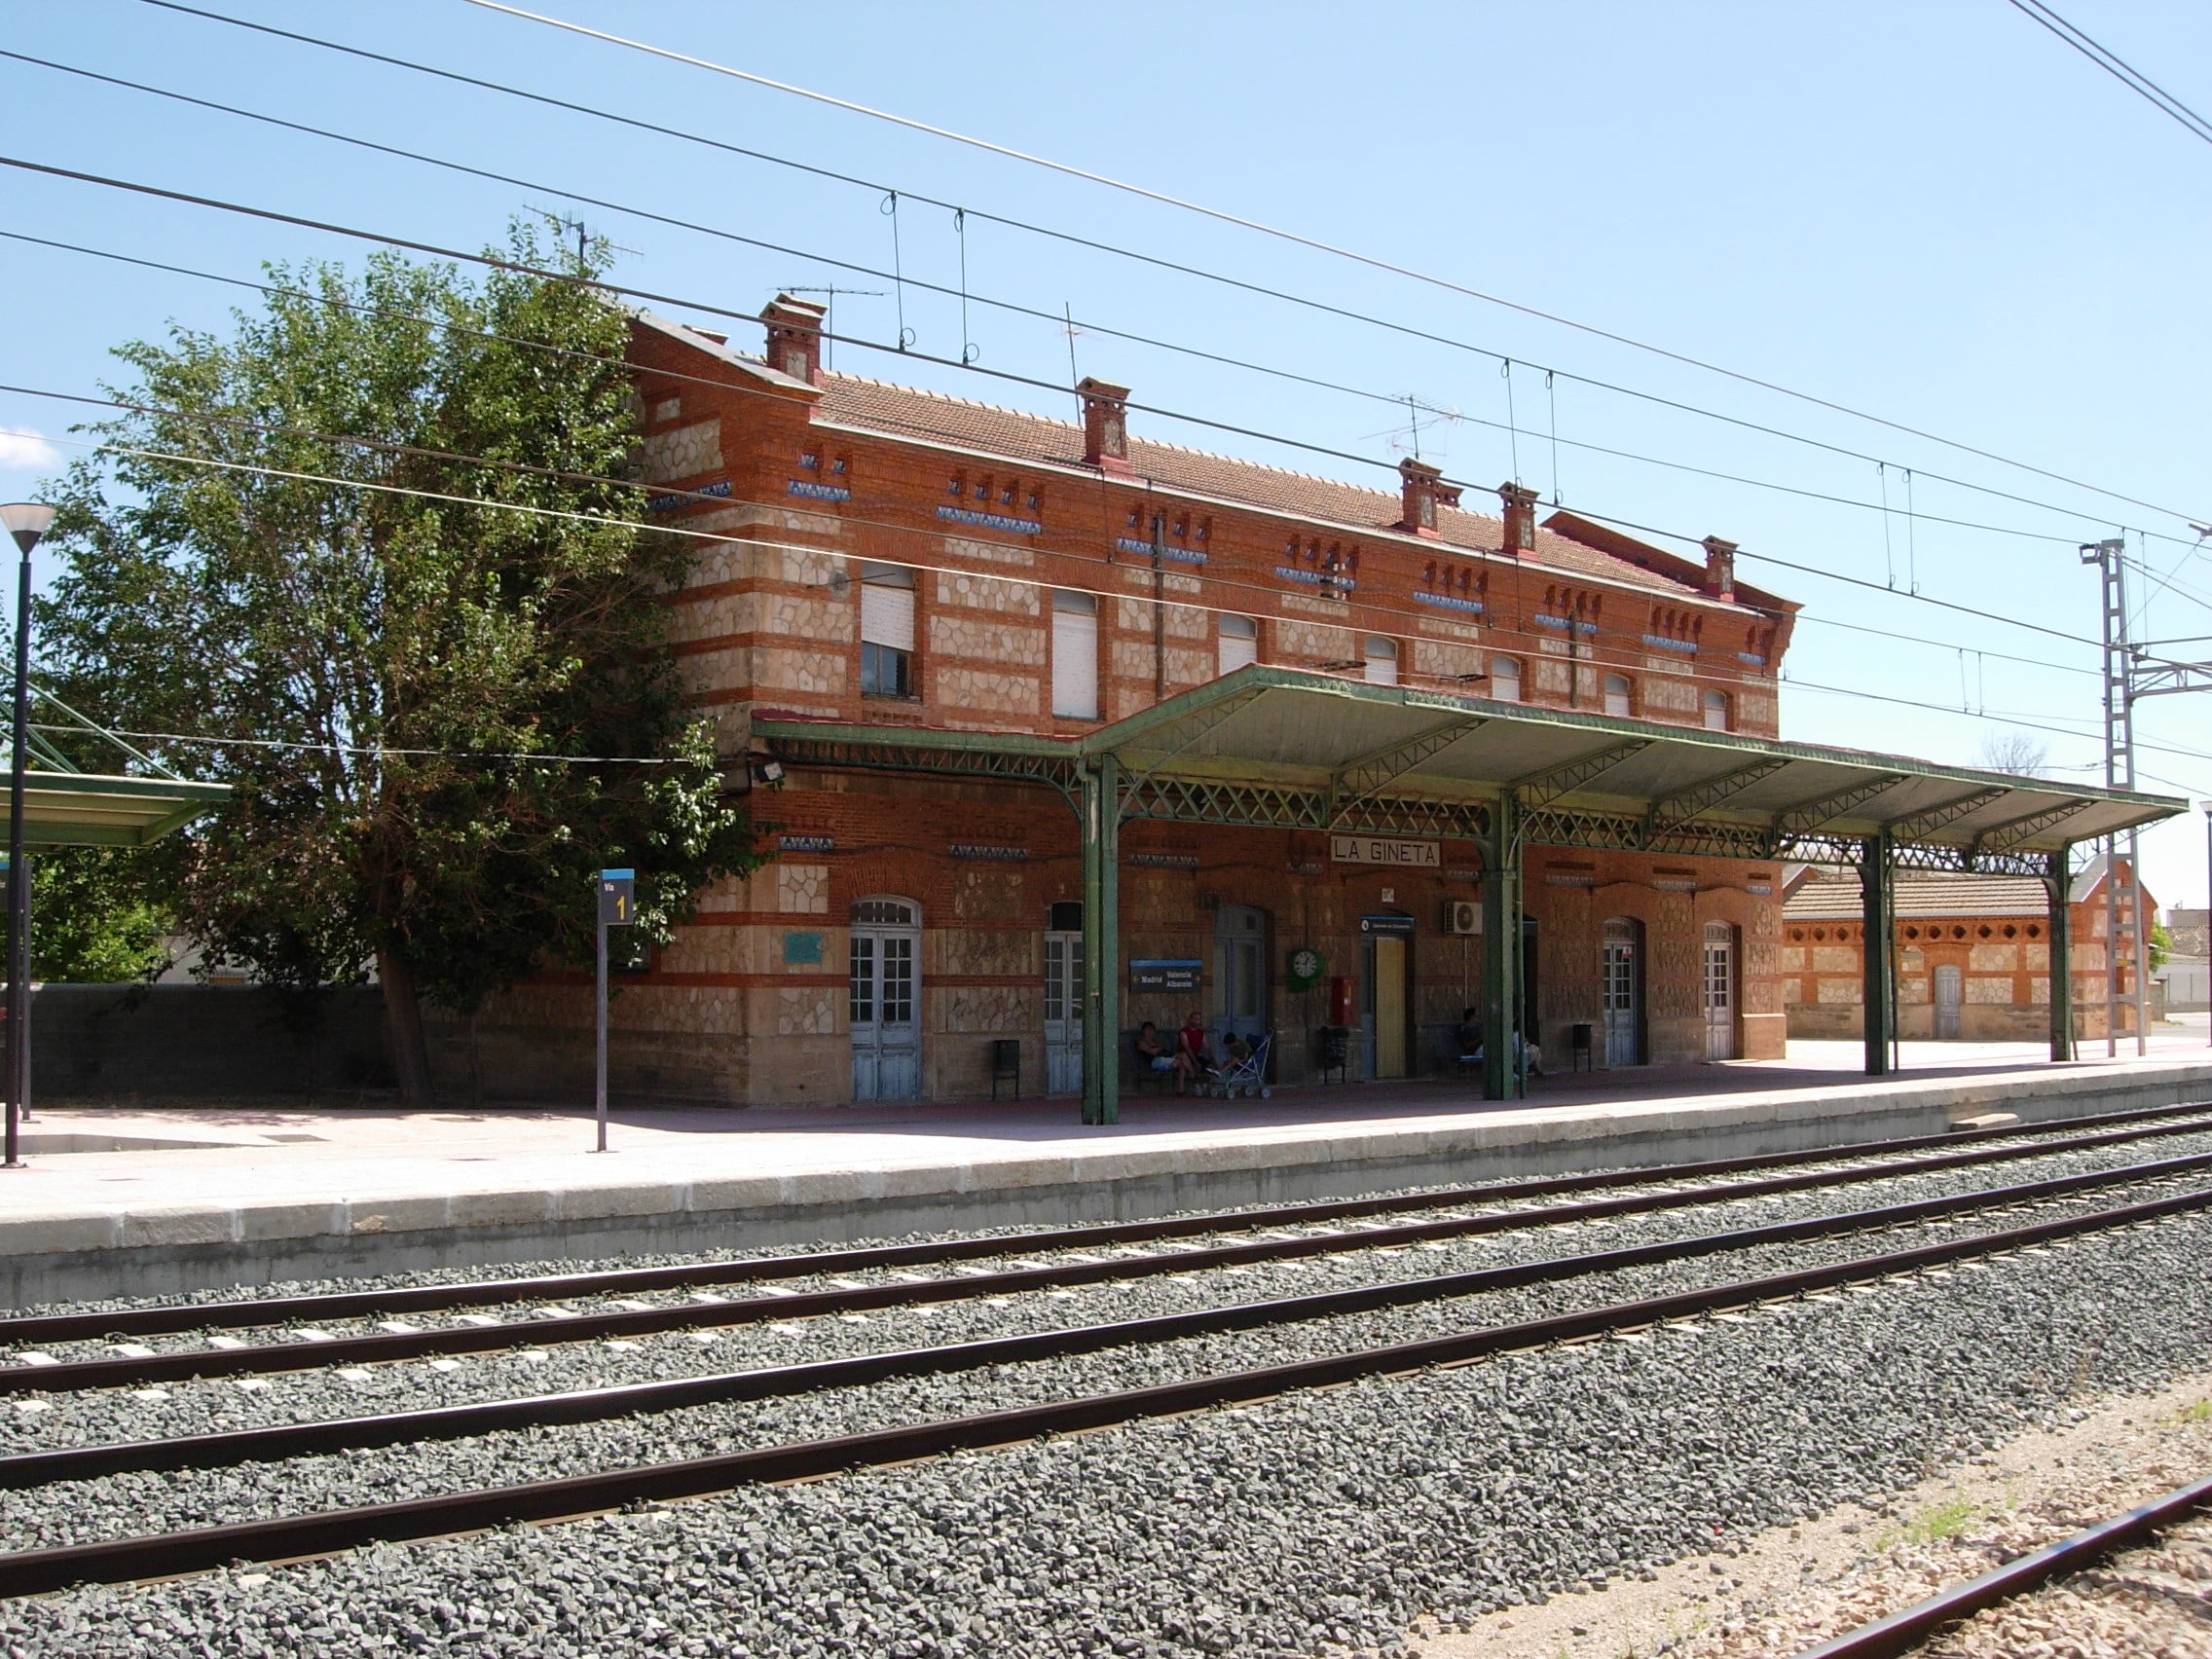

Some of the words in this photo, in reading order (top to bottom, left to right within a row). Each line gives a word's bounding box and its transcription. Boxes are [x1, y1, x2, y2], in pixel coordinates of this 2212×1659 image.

[1334, 840, 1360, 859] LA
[1370, 842, 1436, 864] GINETA
[616, 895, 626, 920] 1
